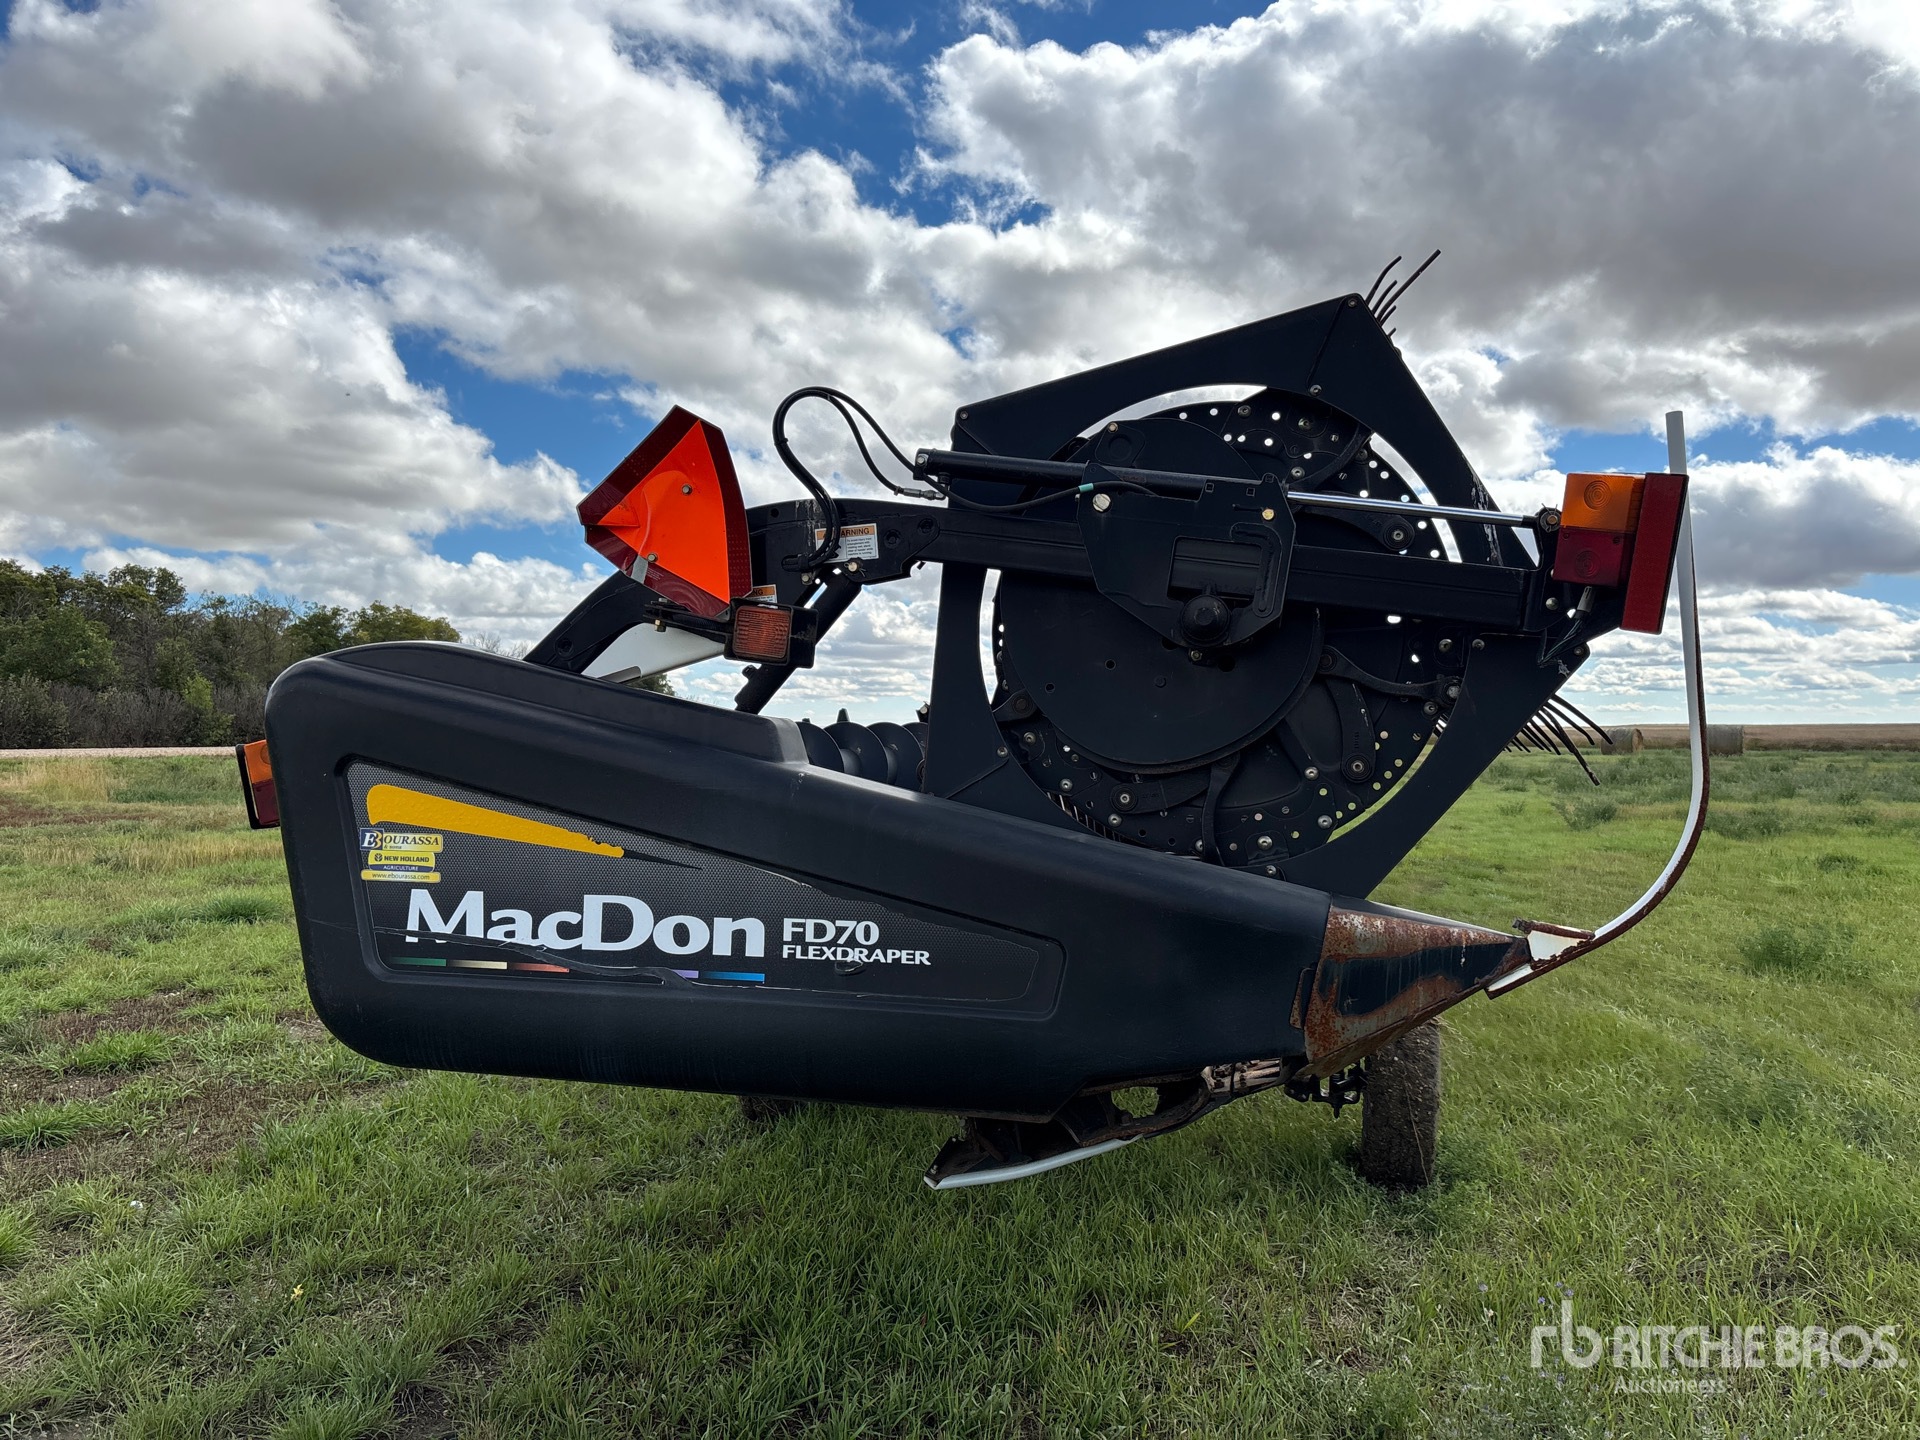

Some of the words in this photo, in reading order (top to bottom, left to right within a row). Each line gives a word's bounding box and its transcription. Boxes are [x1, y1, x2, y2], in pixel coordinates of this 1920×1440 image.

[840, 527, 870, 537] ARNING
[400, 855, 430, 863] HOLLAND
[372, 872, 431, 880] www.ebourassa.com
[404, 888, 766, 958] MacDon
[782, 917, 880, 946] FD70
[782, 944, 932, 966] FLEXDRAPER
